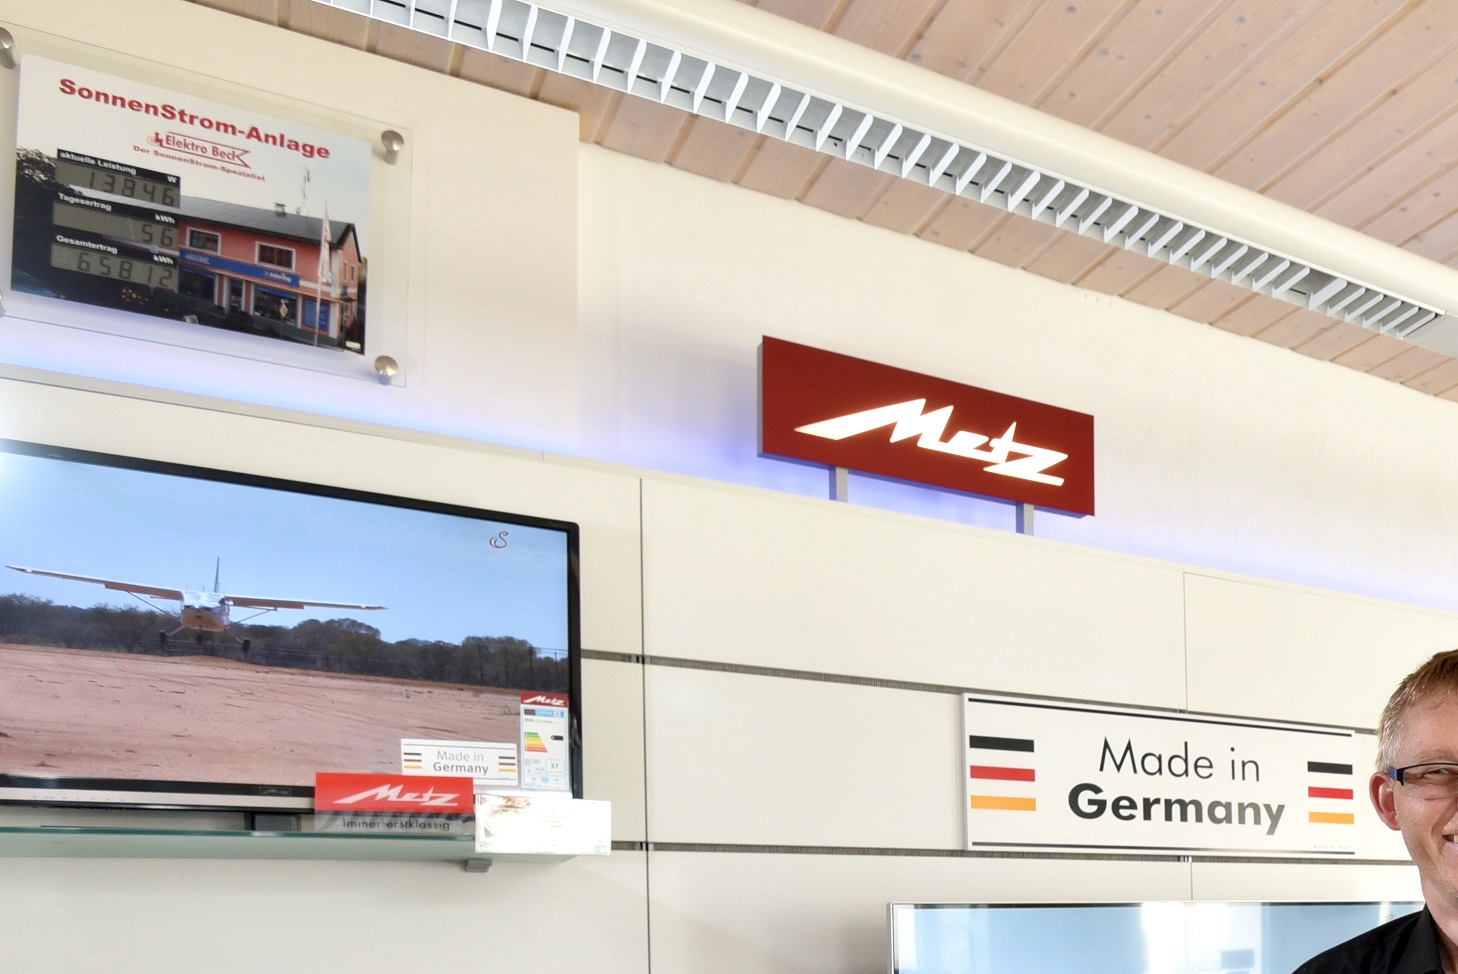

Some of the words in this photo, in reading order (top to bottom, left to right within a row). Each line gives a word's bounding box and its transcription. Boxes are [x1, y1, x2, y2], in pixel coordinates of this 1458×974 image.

[59, 78, 330, 158] SonnenStrom-Anlage
[166, 134, 208, 154] Elektro
[212, 146, 238, 161] Beck
[60, 150, 96, 165] aktuelle
[97, 159, 137, 175] Leistung
[167, 175, 177, 183] W
[133, 145, 150, 154] Der
[153, 150, 266, 181] SonnenStrom-Spezialist
[89, 171, 175, 206] 13846
[58, 192, 112, 212] Tagesertrag
[155, 213, 175, 224] kWh
[56, 234, 118, 255] Gesamtertrag
[141, 223, 174, 246] 56
[78, 251, 173, 287] 65812
[153, 254, 174, 264] kWh
[794, 398, 1069, 487] Metz
[523, 694, 566, 707] Metz
[436, 750, 470, 762] Made
[473, 751, 485, 762] in
[1098, 736, 1214, 780] Made
[1229, 747, 1261, 782] in
[433, 763, 490, 776] Germany
[332, 783, 460, 807] Metz
[1068, 782, 1286, 836] Germany
[342, 818, 381, 829] immer
[386, 818, 450, 832] erstklassig
